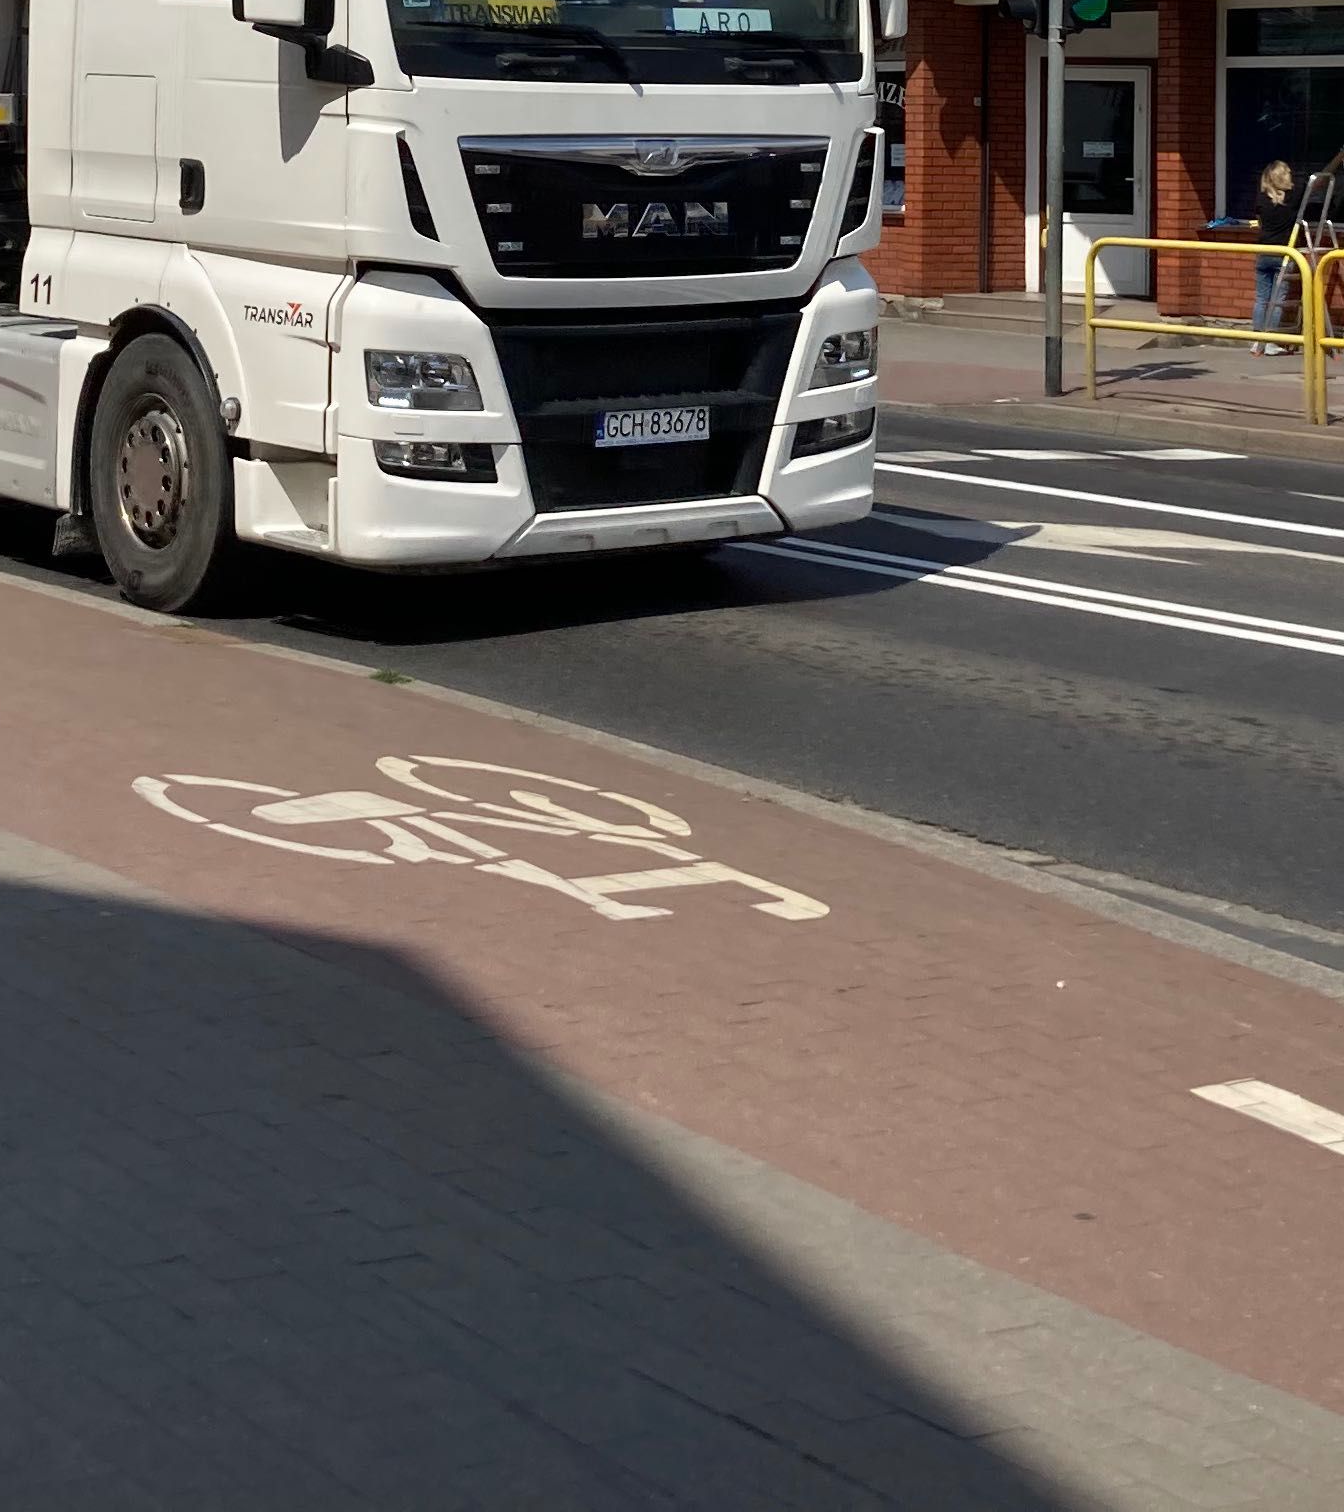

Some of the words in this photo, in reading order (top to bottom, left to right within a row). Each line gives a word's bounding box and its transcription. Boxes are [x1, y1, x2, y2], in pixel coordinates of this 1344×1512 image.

[582, 202, 729, 238] MAN
[30, 273, 53, 305] 11
[243, 302, 314, 329] TRANSMAR
[607, 413, 645, 438] GCH
[650, 408, 706, 435] 83678
